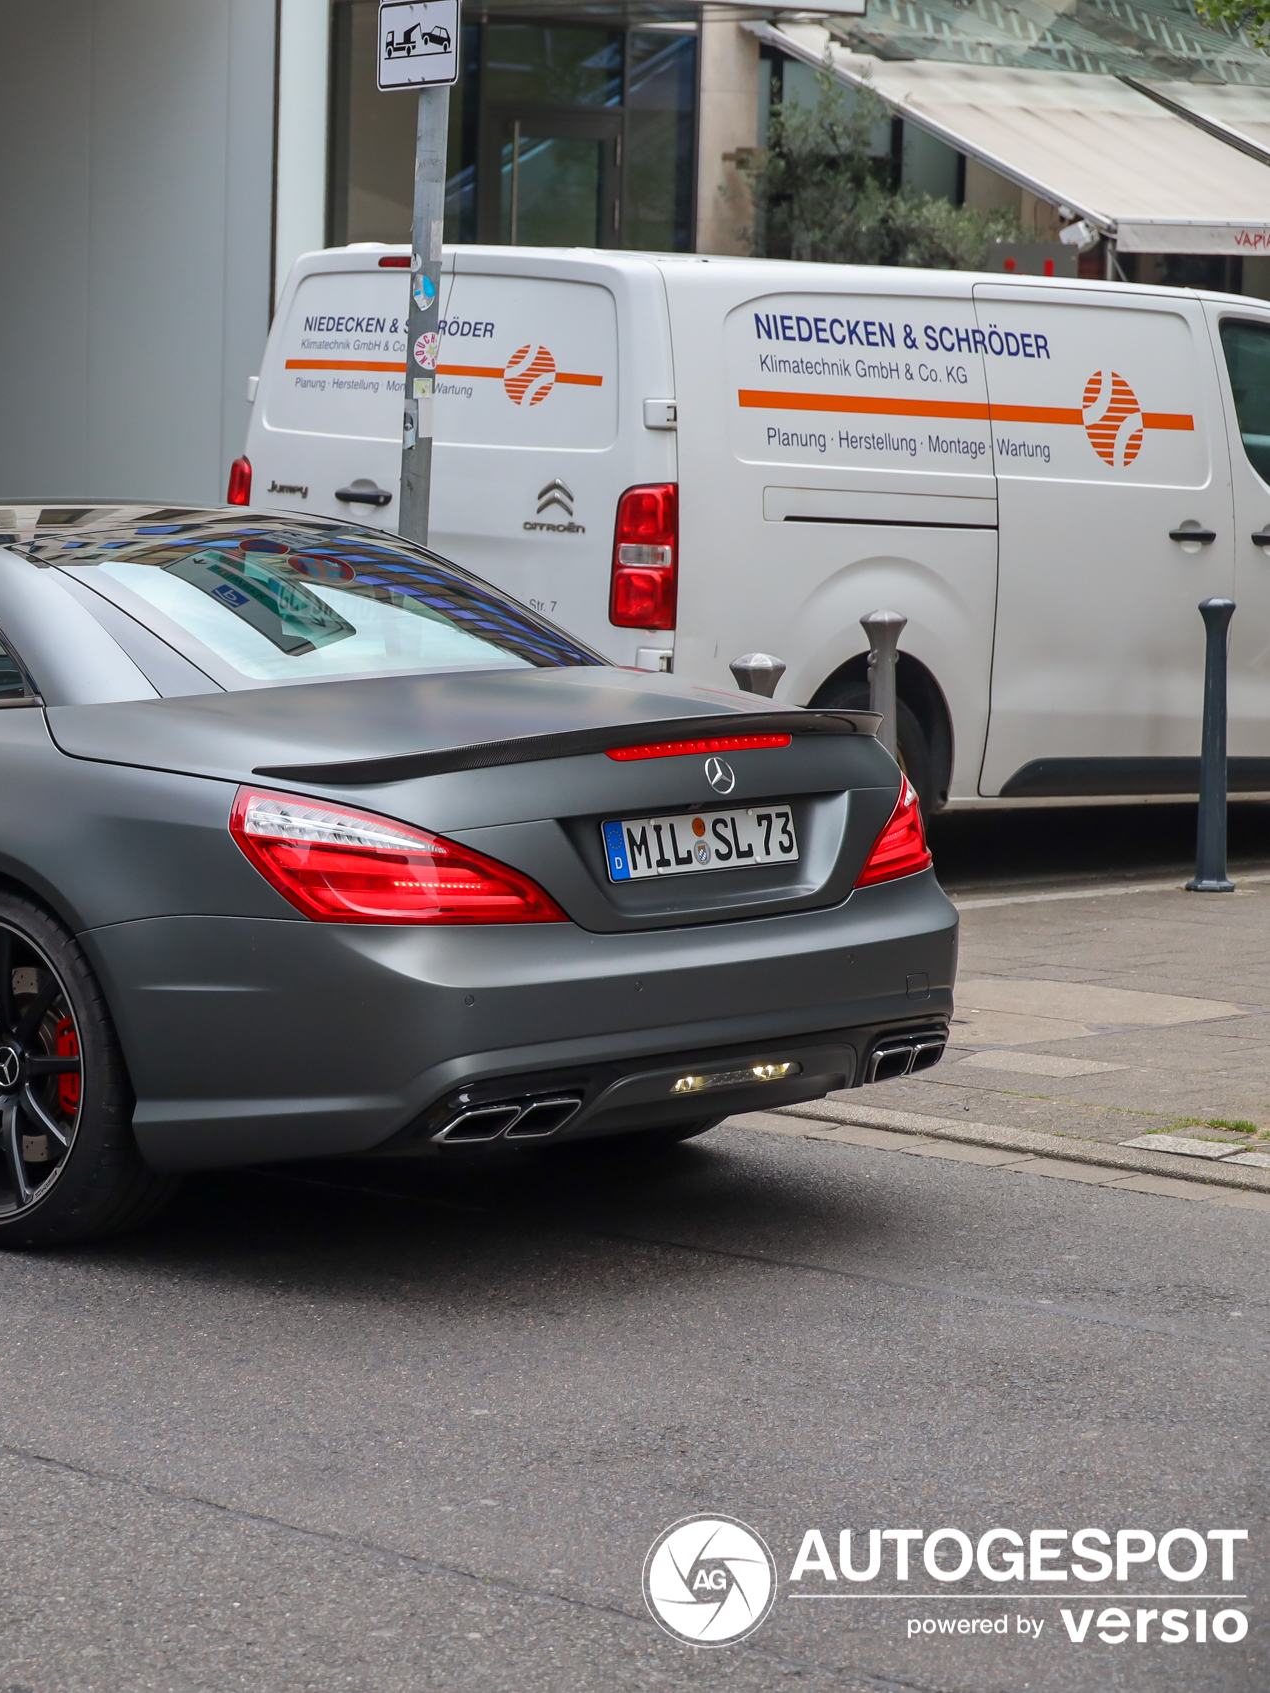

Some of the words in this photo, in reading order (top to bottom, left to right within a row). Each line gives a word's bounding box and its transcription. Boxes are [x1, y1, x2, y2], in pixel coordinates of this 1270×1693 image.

[303, 316, 386, 334] NIEDECKEN
[389, 318, 399, 334] &
[754, 312, 896, 349] NIEDECKEN
[903, 324, 919, 350] &
[924, 324, 1051, 360] SCHRÖDER
[300, 338, 351, 351] Klimatechnik
[353, 339, 382, 352] GmbH
[383, 341, 390, 352] &
[759, 353, 852, 378] Klimatechnik
[855, 359, 900, 380] GmbH
[904, 363, 915, 381] &
[918, 363, 942, 383] Co.
[946, 366, 968, 384] KG
[295, 377, 327, 391] Planung
[332, 378, 380, 394] Herstellung
[434, 383, 473, 399] Wartung
[766, 427, 827, 453] Planung
[838, 430, 917, 457] Herstellung
[928, 434, 986, 460] Montage
[996, 438, 1051, 463] Wartung
[550, 601, 558, 612] 7
[626, 822, 693, 871] MIL
[711, 816, 754, 862] SL
[756, 811, 794, 856] 73
[614, 856, 623, 870] D
